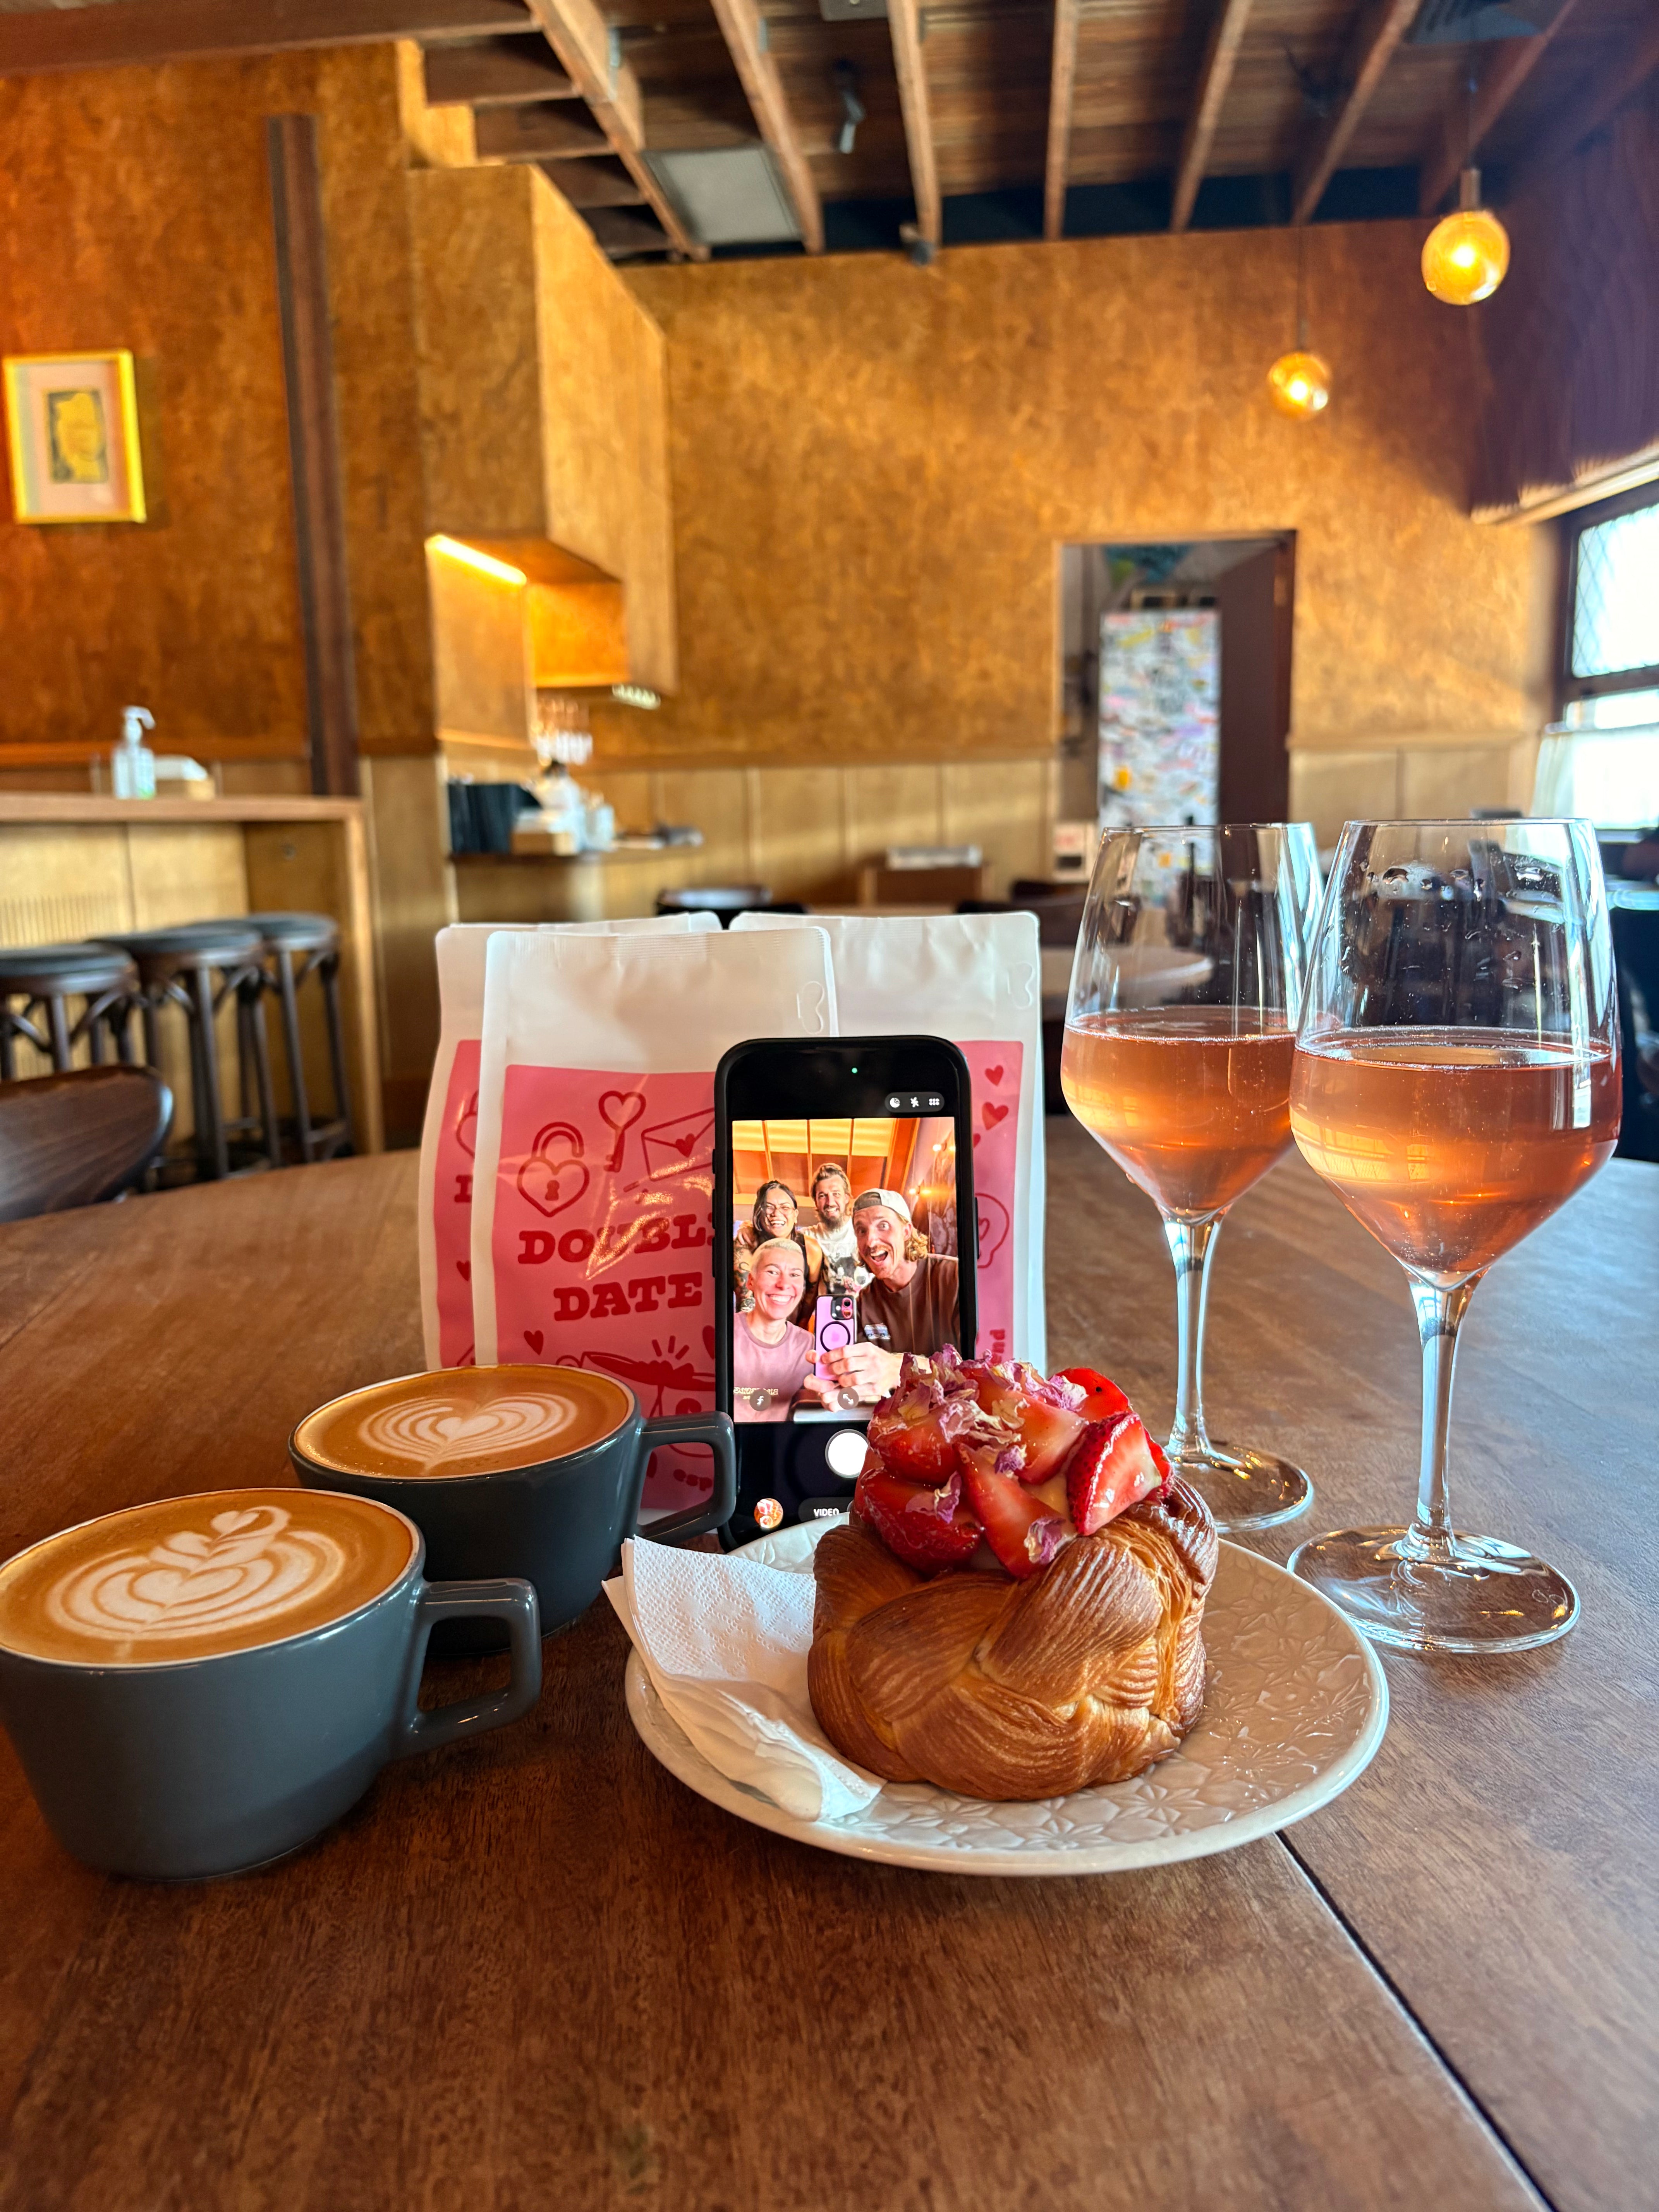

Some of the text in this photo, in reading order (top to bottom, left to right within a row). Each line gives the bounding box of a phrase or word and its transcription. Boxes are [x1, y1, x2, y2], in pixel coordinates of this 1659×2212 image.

[518, 1212, 715, 1264] DOUBL
[553, 1271, 702, 1321] DATE
[813, 1508, 840, 1517] VIDEO
